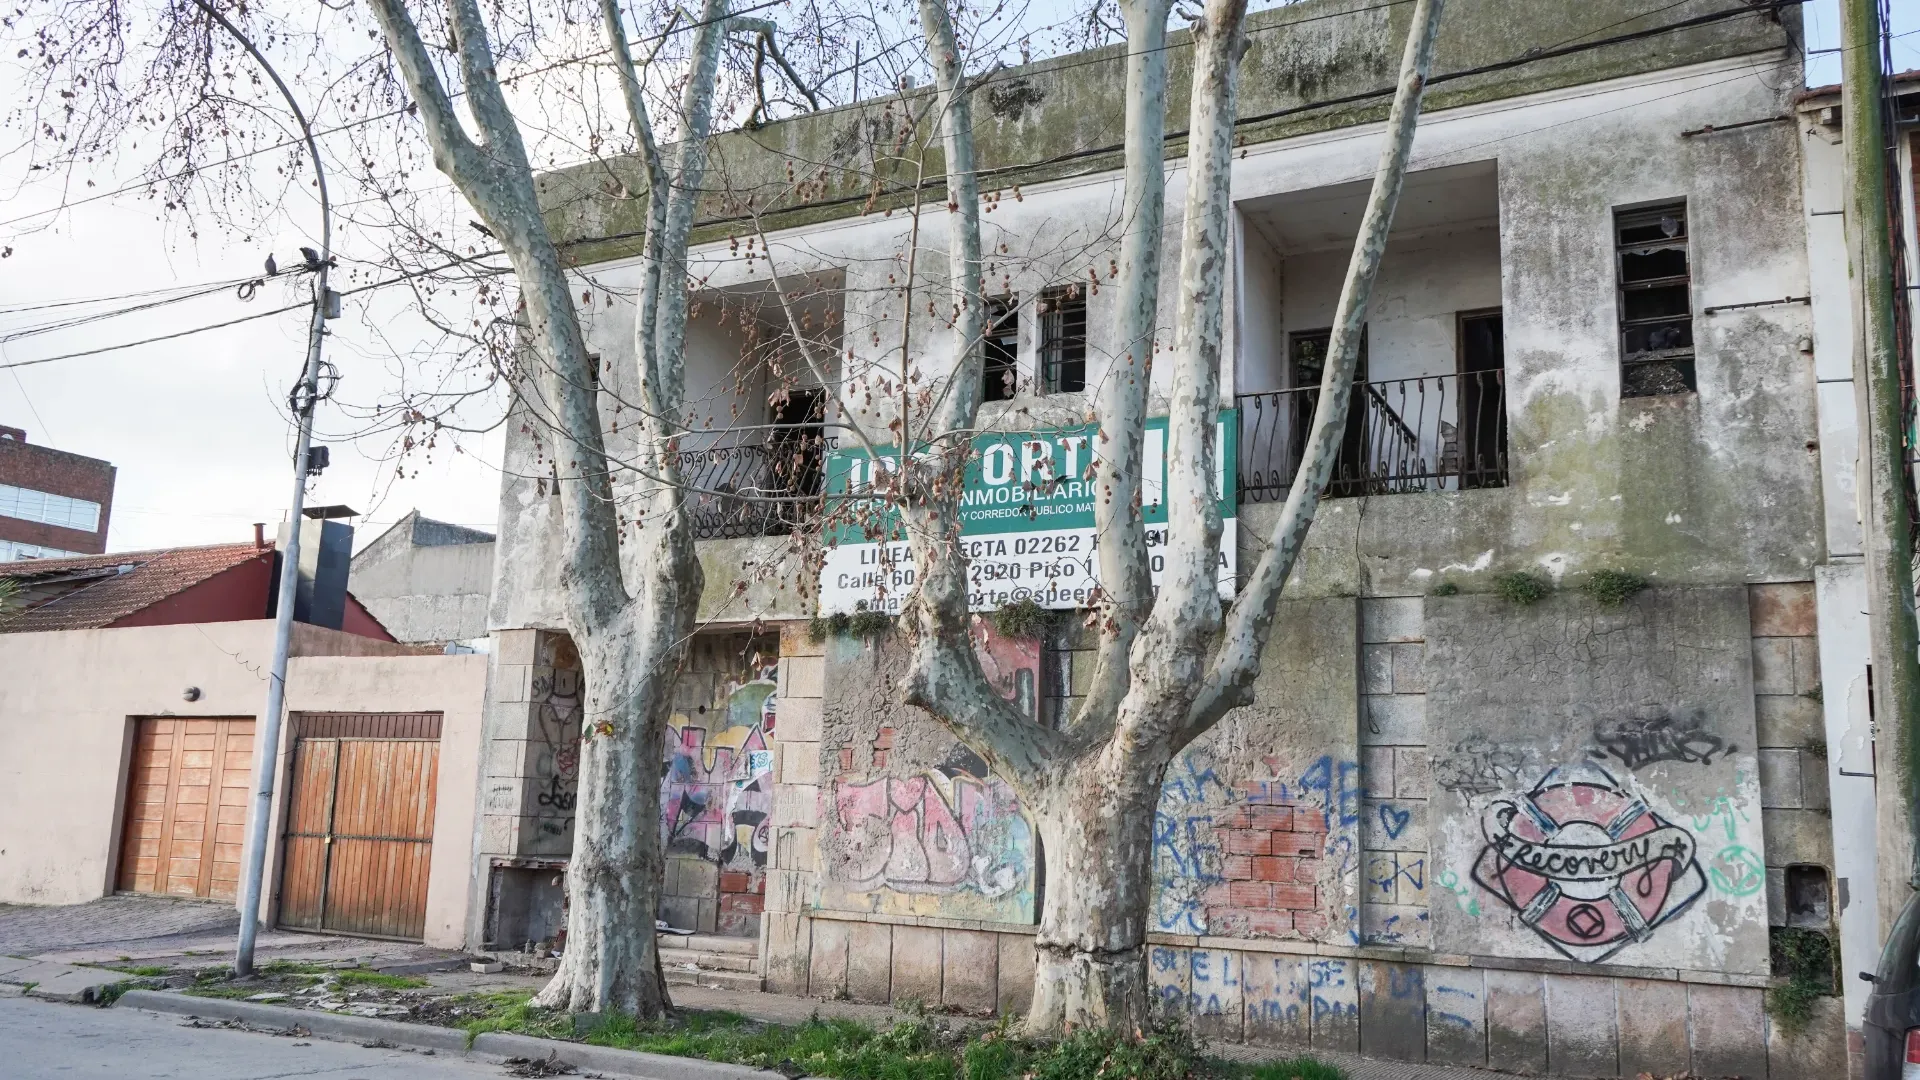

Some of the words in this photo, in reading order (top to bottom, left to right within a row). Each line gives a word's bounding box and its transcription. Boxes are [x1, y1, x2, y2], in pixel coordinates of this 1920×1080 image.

[1014, 534, 1080, 555] 02262
[837, 571, 885, 590] Calle
[970, 562, 1021, 581] 2920
[1029, 561, 1075, 578] Piso
[1500, 836, 1665, 897] Recovery
